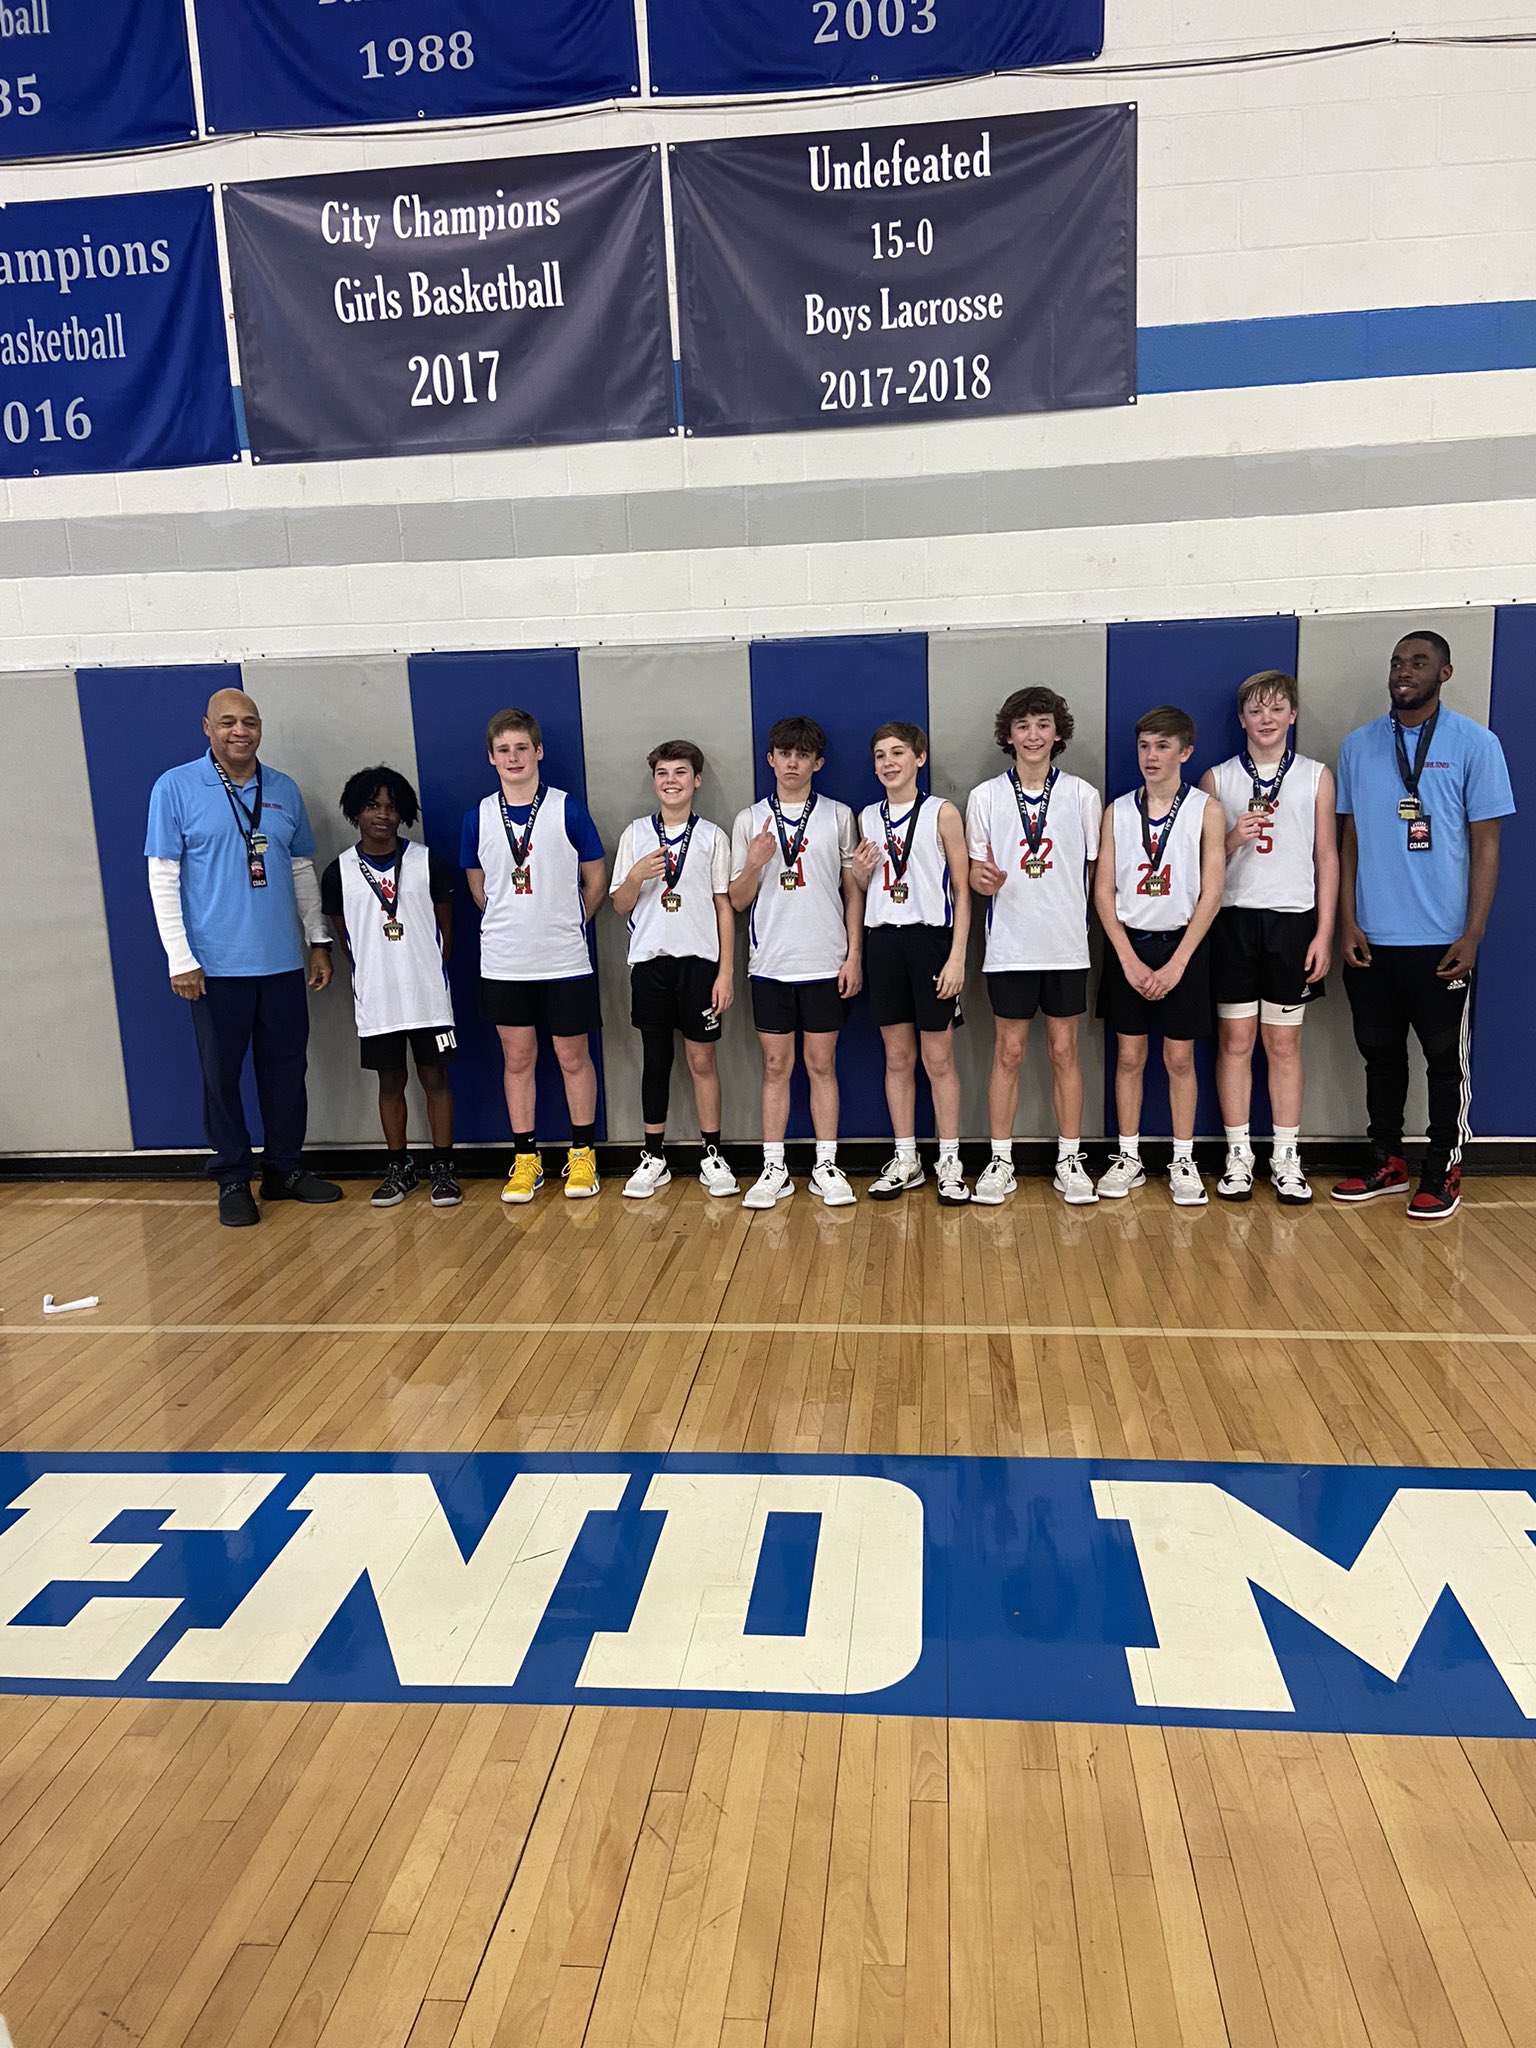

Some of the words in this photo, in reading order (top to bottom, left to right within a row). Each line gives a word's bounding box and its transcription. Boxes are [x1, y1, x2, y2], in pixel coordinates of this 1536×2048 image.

[813, 0, 937, 44] 2003
[359, 30, 474, 79] 1988
[808, 132, 991, 192] Undefeated
[320, 200, 381, 250] City
[392, 189, 561, 241] Champions
[870, 218, 934, 260] 15-0
[0, 234, 170, 294] ampions
[334, 274, 403, 324] Girls
[407, 260, 565, 318] Basketball
[804, 288, 872, 341] Boys
[879, 287, 1003, 331] Lacrosse
[0, 313, 126, 366] asketball
[408, 350, 501, 408] 2017
[819, 353, 992, 411] 2017-2018
[3, 396, 92, 444] 016
[1019, 837, 1054, 870] 22
[1255, 822, 1275, 854] 5
[1409, 841, 1429, 850] COACH
[1136, 863, 1172, 896] 24
